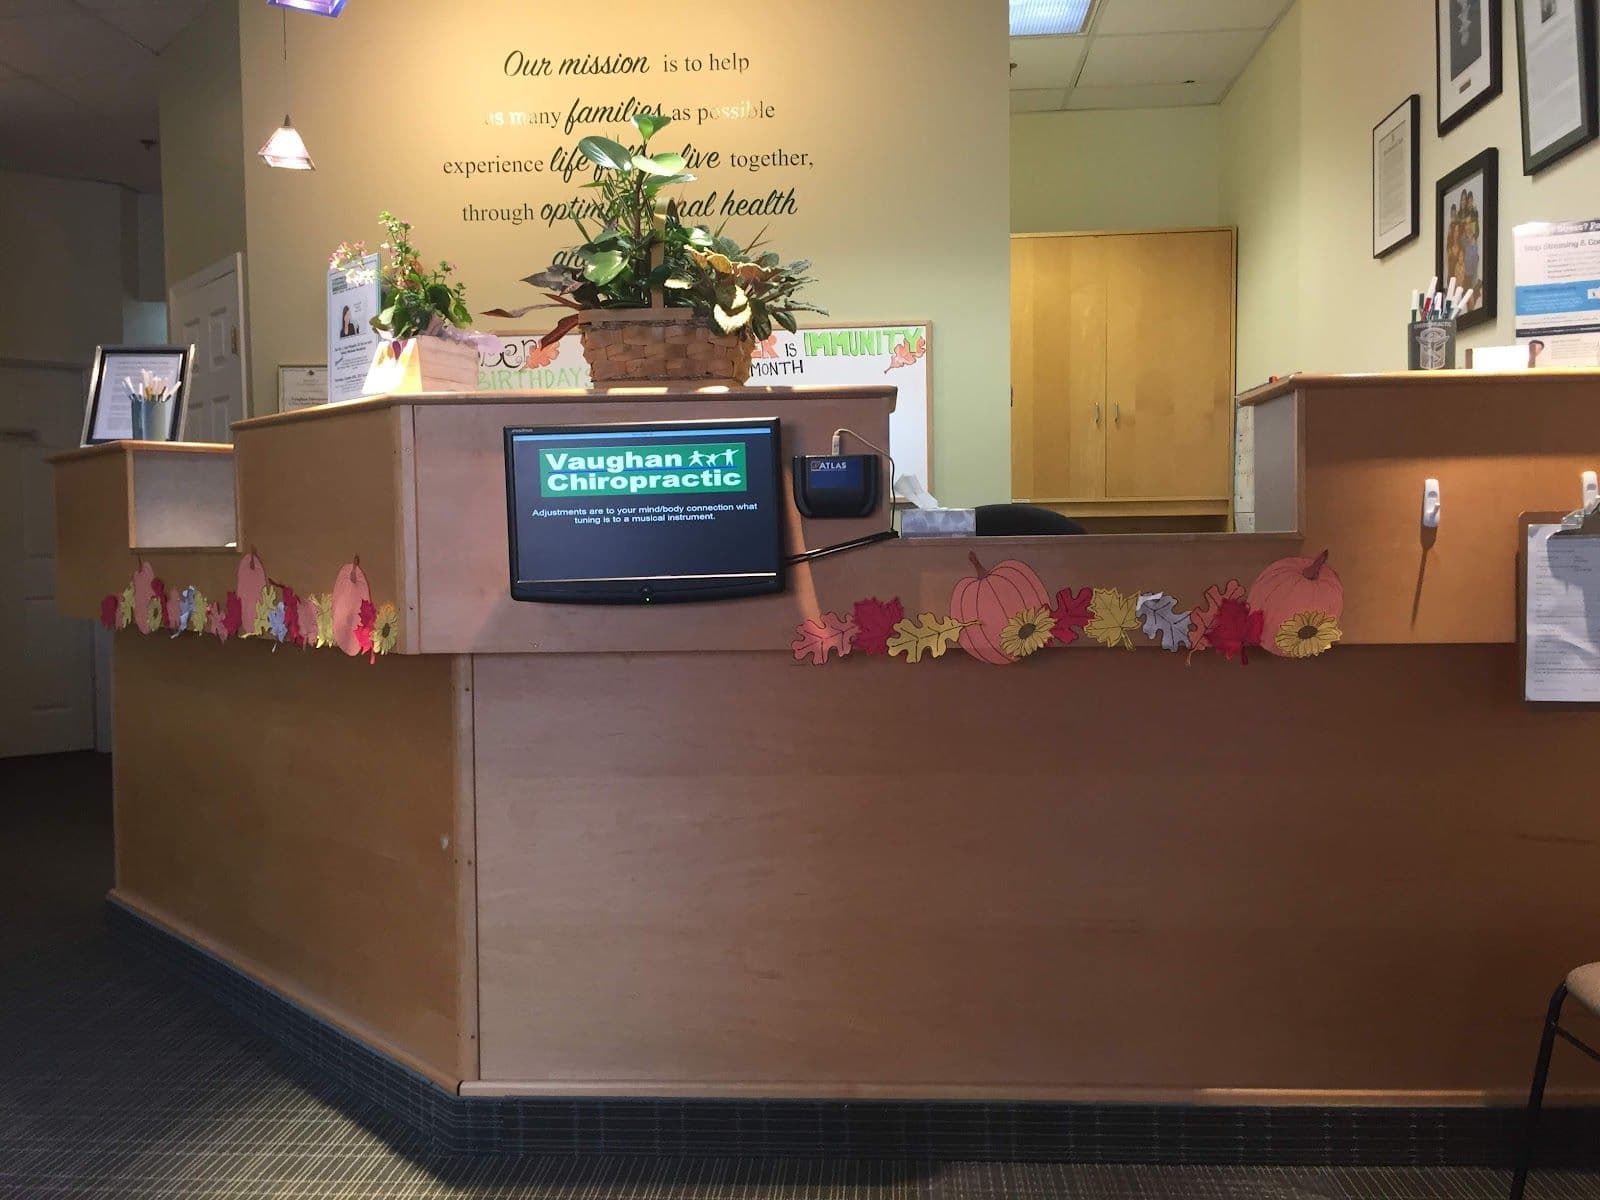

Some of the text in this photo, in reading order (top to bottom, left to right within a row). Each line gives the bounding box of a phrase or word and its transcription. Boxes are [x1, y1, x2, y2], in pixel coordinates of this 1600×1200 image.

[503, 50, 750, 76] Our mission is to help
[483, 96, 775, 135] as many families as possible
[443, 155, 544, 178] experience
[550, 146, 590, 183] life
[671, 143, 721, 169] live
[730, 149, 814, 172] together,
[462, 203, 534, 225] through
[720, 187, 798, 216] health
[785, 343, 797, 358] IS
[804, 327, 925, 357] IMMUNITY
[749, 360, 804, 377] MONTH
[545, 451, 682, 473] Vaughan
[819, 461, 847, 470] ATLAS
[547, 469, 742, 493] Chiropractic
[532, 507, 587, 518] Adjustments
[606, 507, 615, 515] to
[617, 507, 636, 516] your
[639, 505, 684, 514] mind/body
[686, 503, 734, 512] connection
[736, 502, 758, 511] what
[574, 516, 601, 525] tuning
[632, 514, 666, 523] musical
[667, 513, 716, 521] instrument.
